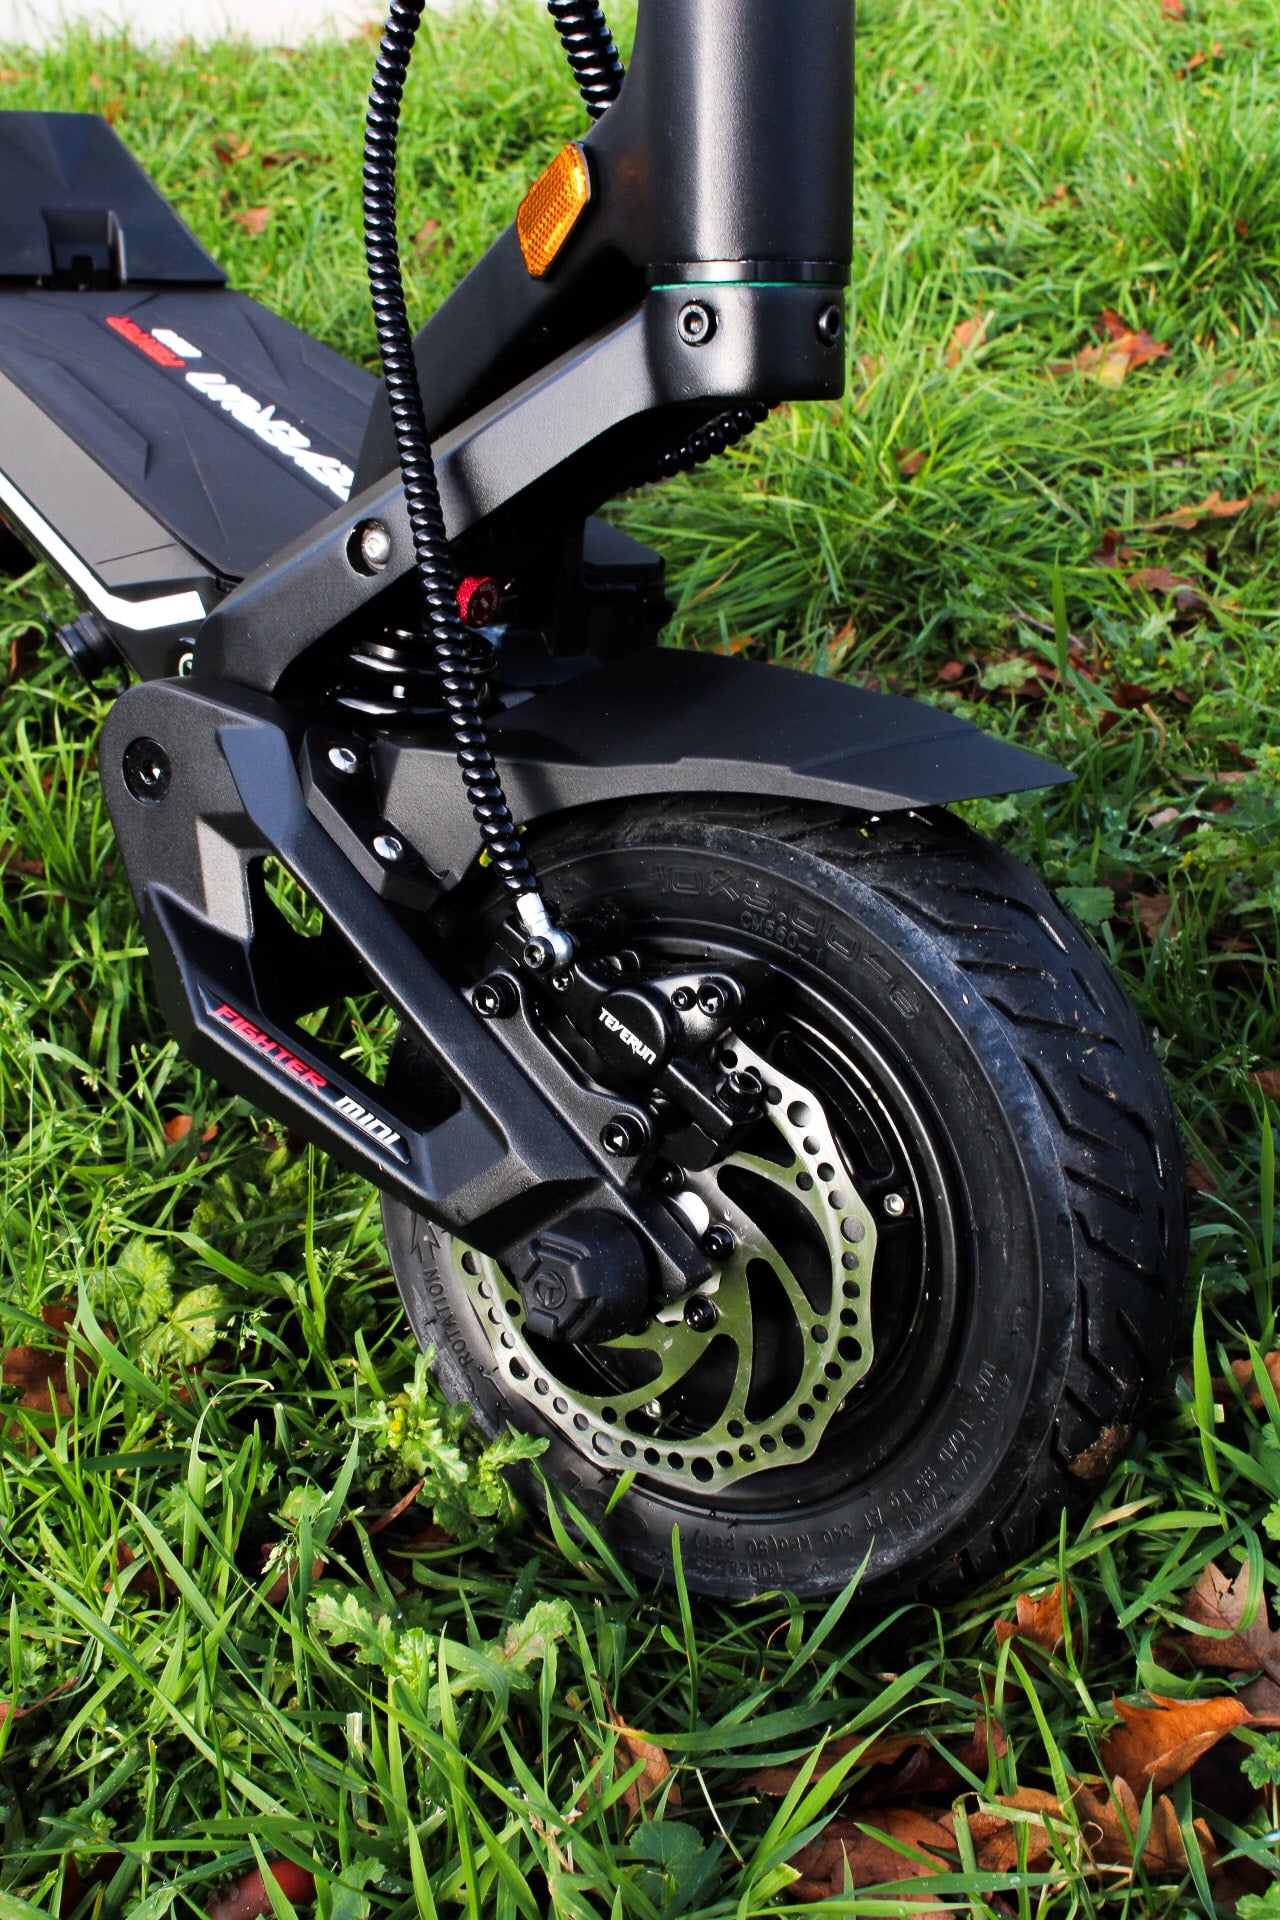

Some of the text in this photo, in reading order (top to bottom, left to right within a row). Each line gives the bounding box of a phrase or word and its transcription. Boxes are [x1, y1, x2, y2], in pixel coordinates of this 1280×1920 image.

[214, 1004, 327, 1092] FIGHTER
[598, 1006, 657, 1066] TEVERUN
[422, 1266, 474, 1368] ROTATION
